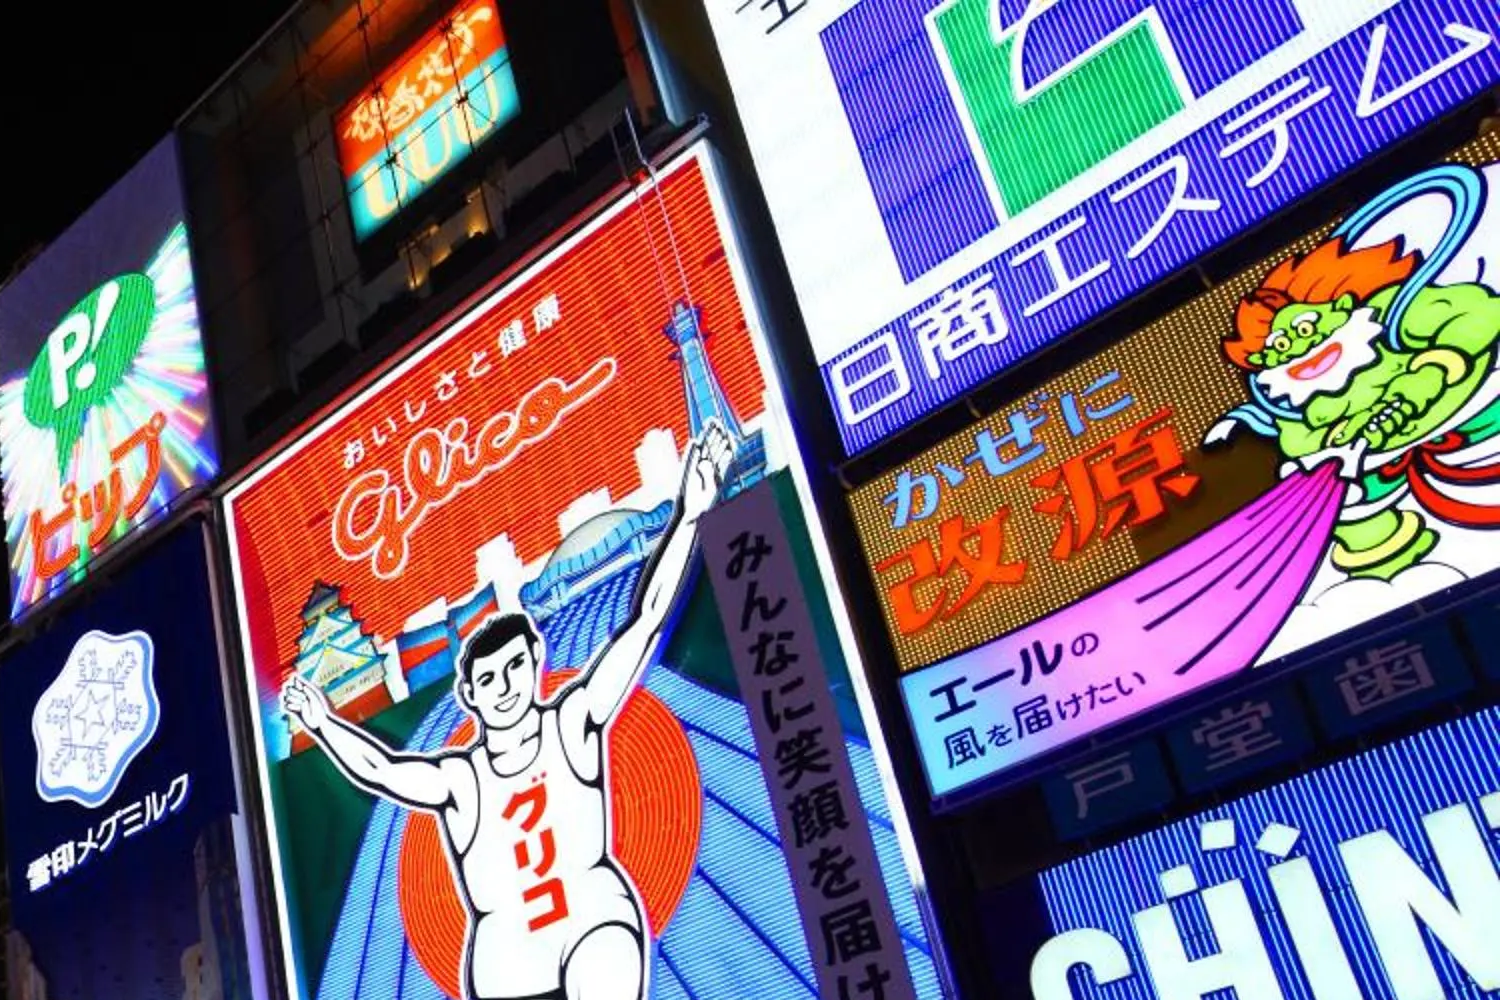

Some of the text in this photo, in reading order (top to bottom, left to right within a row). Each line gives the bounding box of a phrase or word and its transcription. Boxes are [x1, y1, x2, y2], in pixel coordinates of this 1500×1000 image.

[831, 23, 1491, 425] 日商エステム
[343, 293, 562, 469] おいしさと健康
[883, 370, 1135, 529] かぜに
[31, 411, 167, 579] ピップ
[876, 407, 1201, 634] 改源
[929, 630, 1100, 723] エールの
[944, 668, 1147, 770] 風を届けたい
[26, 774, 189, 892] 雪印メグミルク
[501, 771, 569, 932] グリコ
